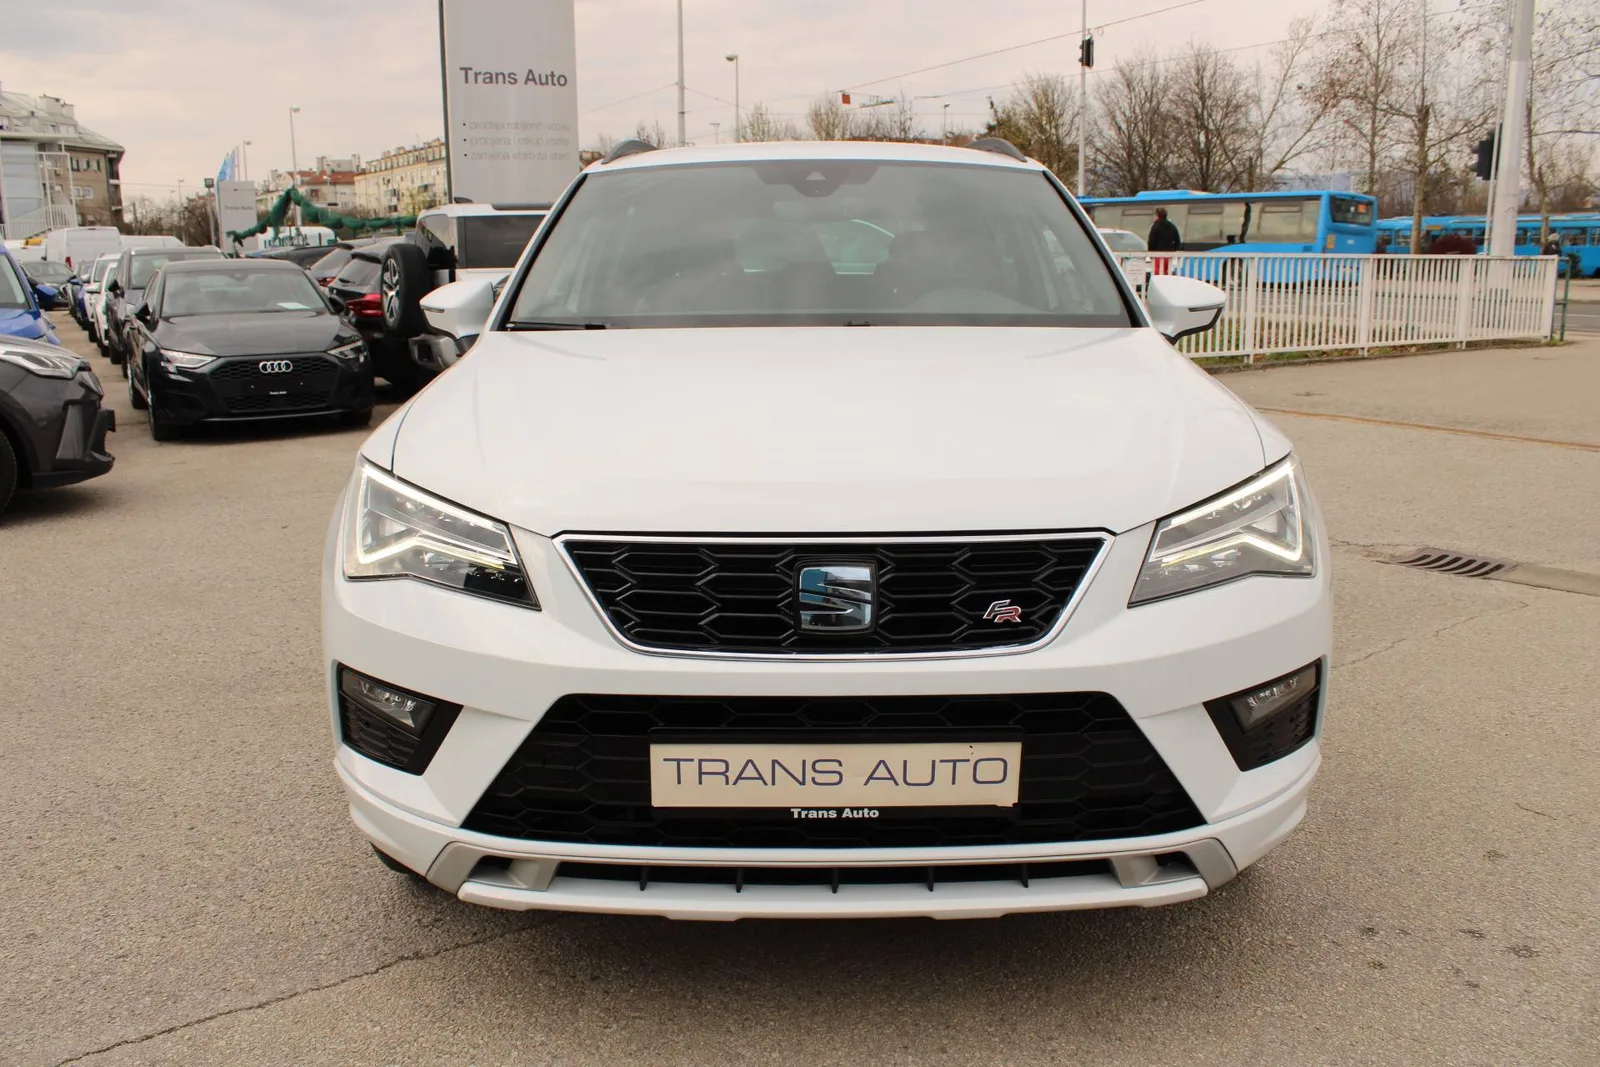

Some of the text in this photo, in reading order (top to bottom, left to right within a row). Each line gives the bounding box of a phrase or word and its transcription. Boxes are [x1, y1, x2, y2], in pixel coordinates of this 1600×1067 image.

[459, 67, 568, 87] Trans Auto
[982, 598, 1022, 623] FR
[663, 757, 1009, 787] TRANS AUTO
[790, 808, 880, 819] Trans Auto
